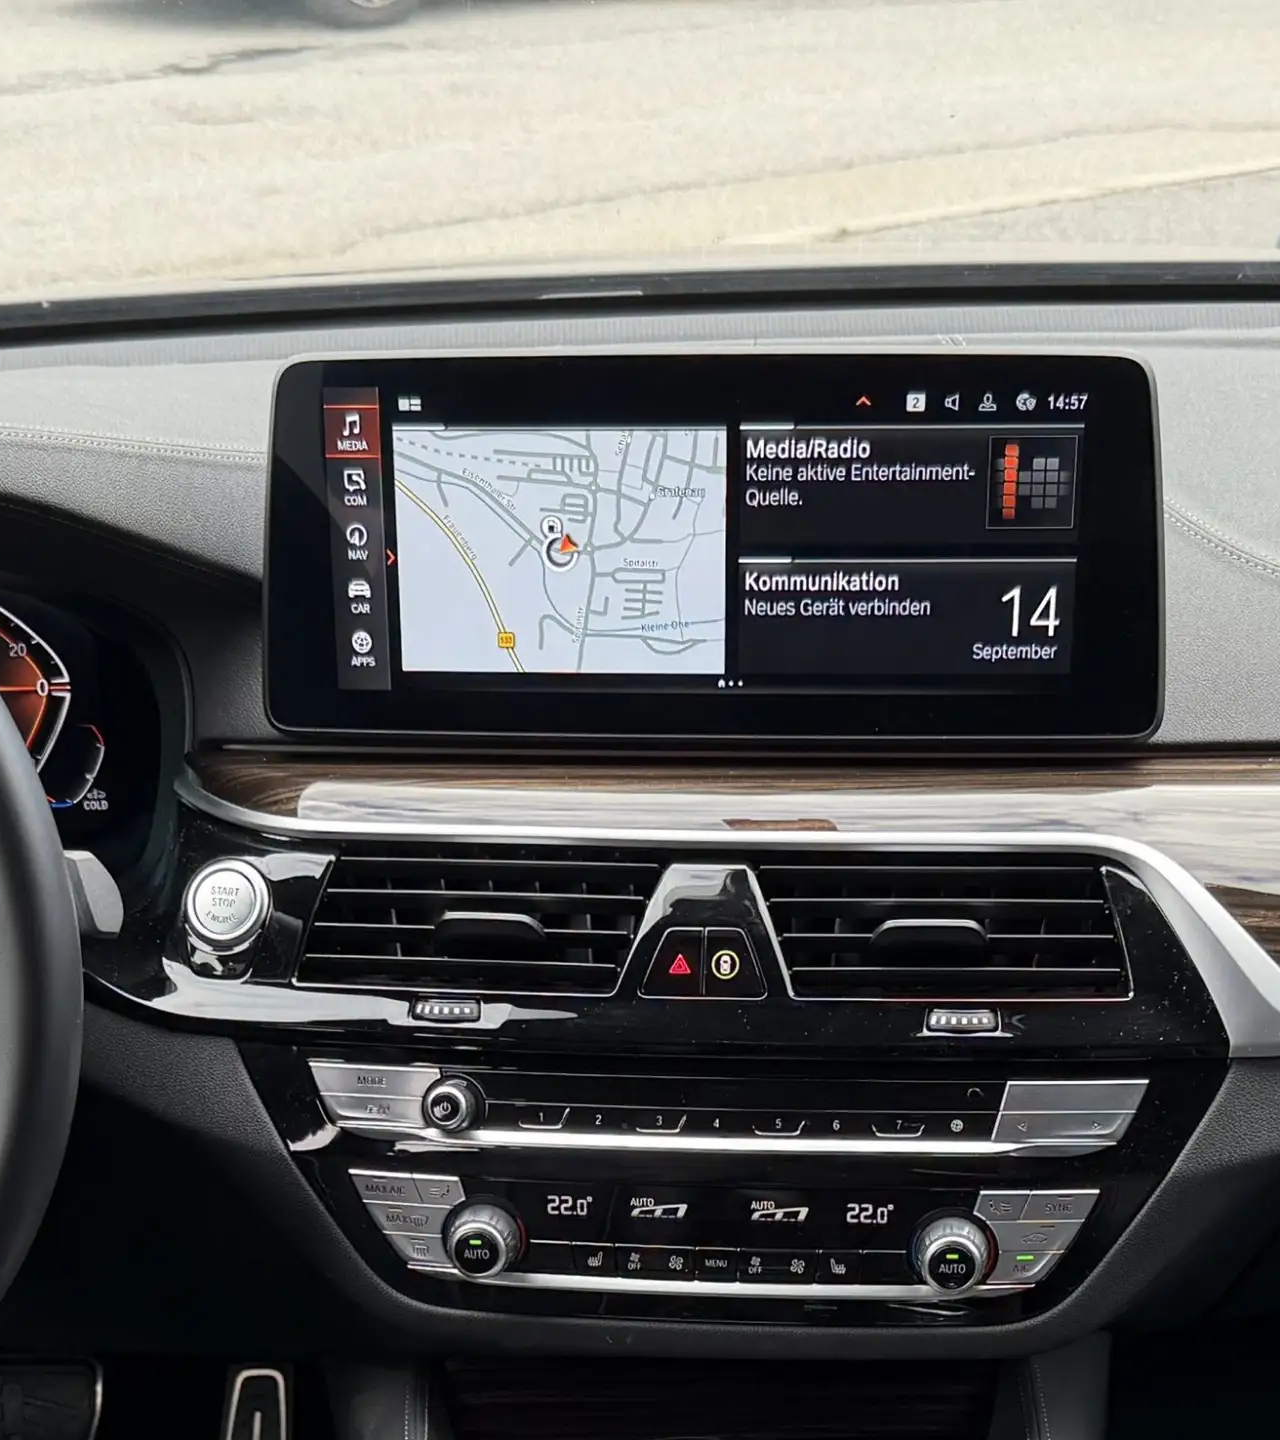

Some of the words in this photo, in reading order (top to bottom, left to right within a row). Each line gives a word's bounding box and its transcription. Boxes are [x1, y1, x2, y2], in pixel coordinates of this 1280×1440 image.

[1047, 393, 1088, 411] 14:57
[337, 439, 368, 451] MEDIA
[746, 437, 871, 460] Media/Radio
[746, 463, 793, 482] Keine
[797, 463, 846, 482] aktive
[850, 463, 976, 482] Entertainment-
[344, 496, 368, 507] COM
[746, 489, 803, 506] Quelle.
[348, 549, 369, 560] NAV
[744, 571, 900, 592] Kommunikation
[350, 604, 371, 614] CAR
[744, 599, 796, 616] Neues
[800, 597, 845, 617] Gerät
[849, 598, 931, 616] verbinden
[1001, 585, 1061, 637] 14
[641, 622, 671, 633] Kleine
[9, 643, 27, 658] 20
[972, 643, 1058, 662] September
[351, 656, 376, 667] APPS
[36, 679, 50, 697] 0
[83, 800, 109, 811] COLD
[211, 886, 241, 897] START
[211, 898, 236, 908] STOP
[205, 910, 239, 923] ENGINE
[357, 1075, 387, 1087] MODE
[537, 1112, 544, 1122] 1
[595, 1114, 602, 1125] 2
[655, 1115, 663, 1126] 3
[712, 1117, 720, 1128] 4
[775, 1118, 782, 1130] 5
[832, 1119, 840, 1131] 6
[896, 1119, 903, 1131] 7
[365, 1184, 388, 1193] MAX
[630, 1198, 654, 1207] AUTO
[750, 1201, 775, 1209] AUTO
[1045, 1203, 1073, 1213] SYNC
[386, 1213, 408, 1223] MAX
[464, 1249, 490, 1260] AUTO
[628, 1261, 641, 1270] OFF
[705, 1258, 727, 1267] MENU
[748, 1265, 763, 1274] OFF
[939, 1263, 966, 1274] AUTO
